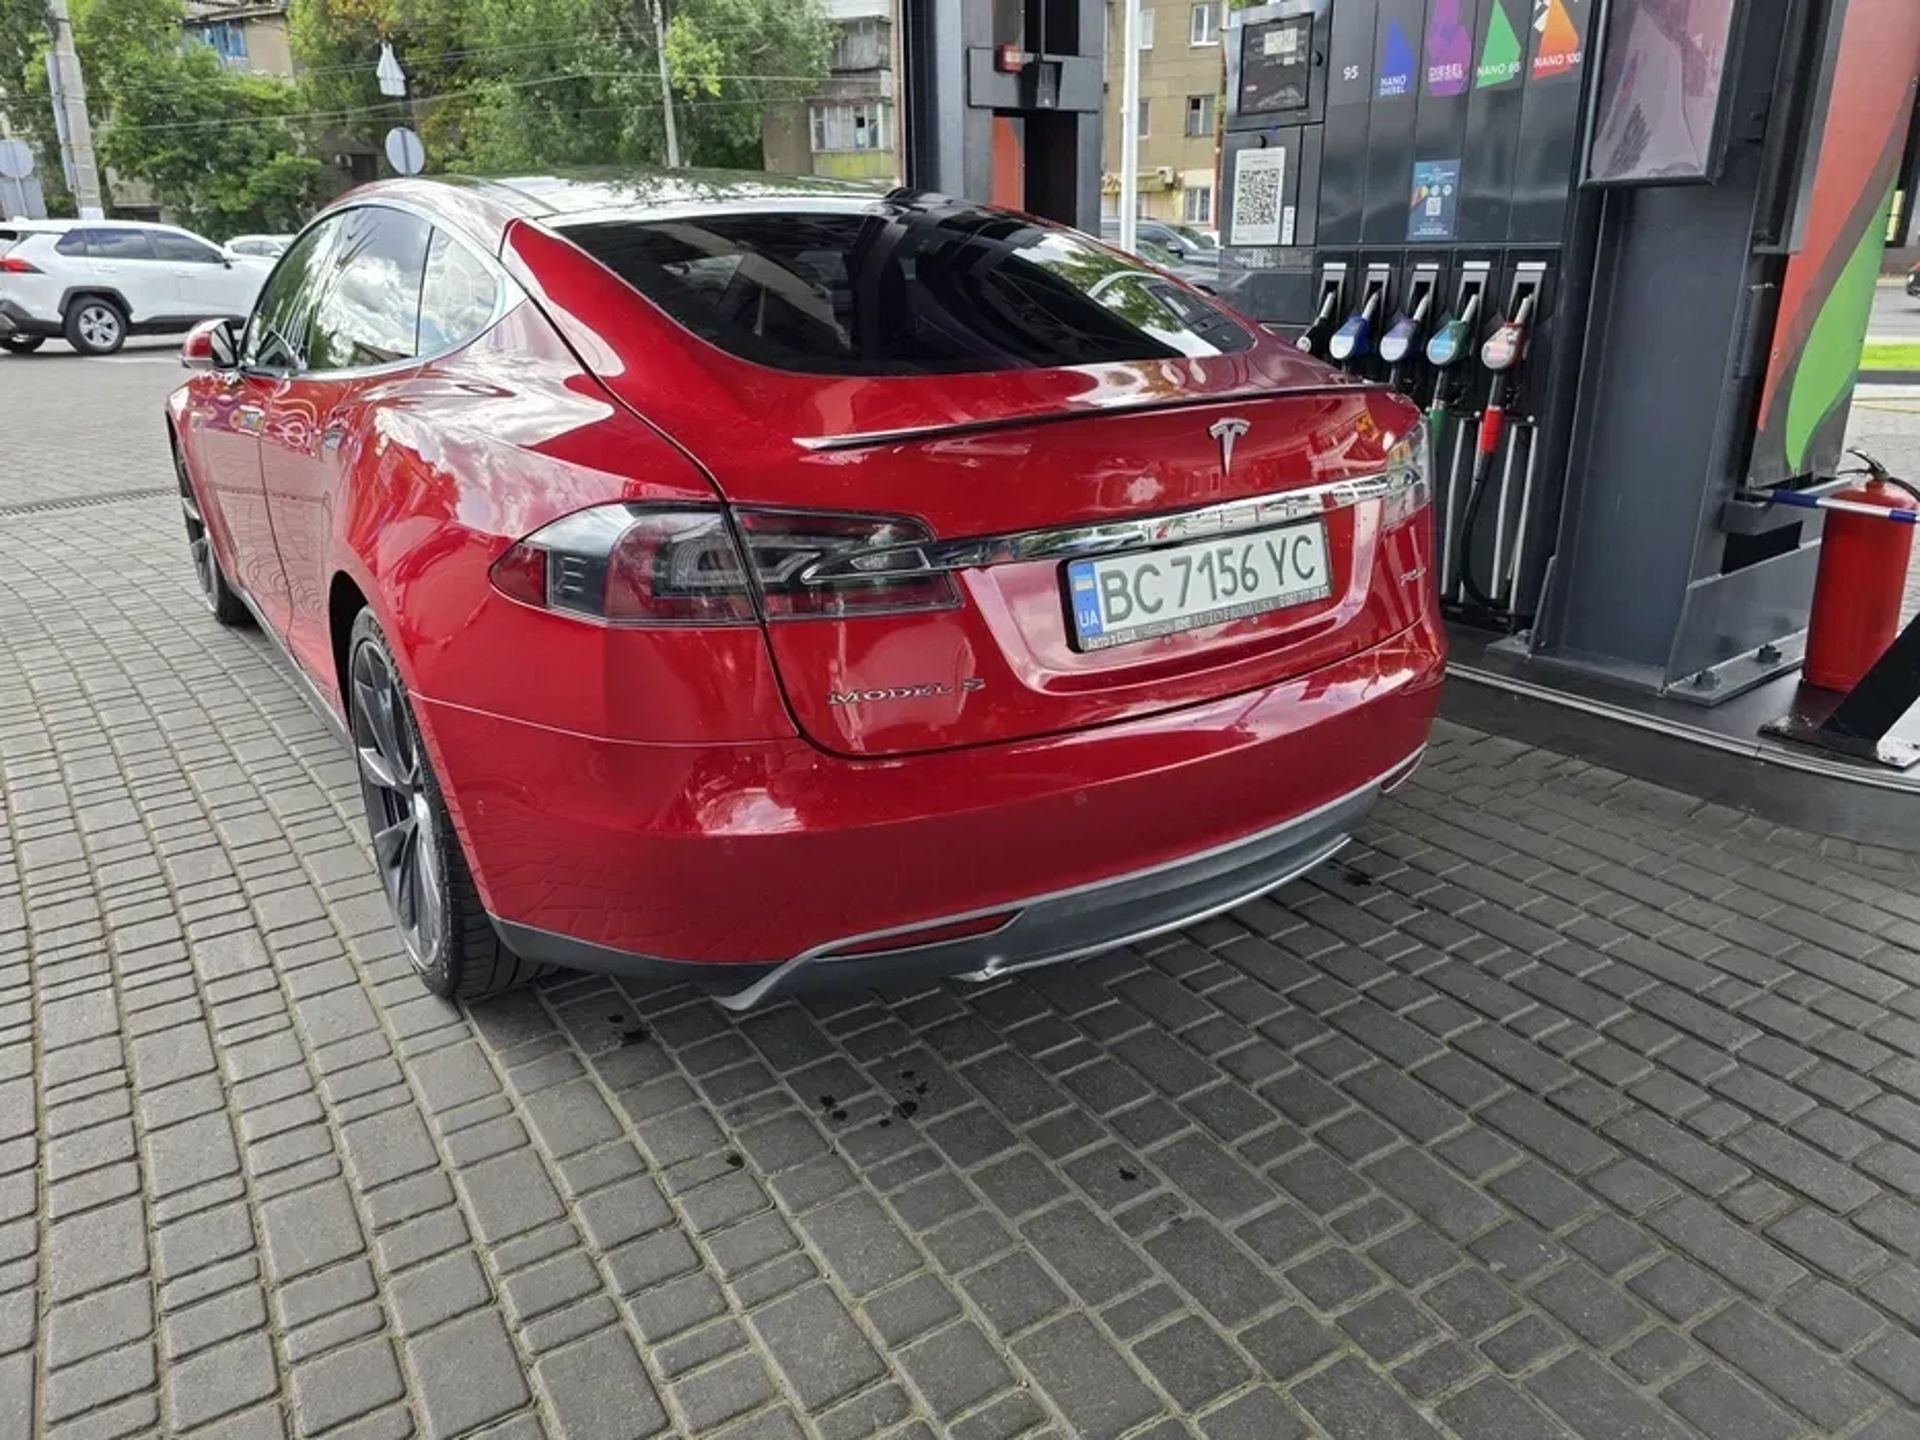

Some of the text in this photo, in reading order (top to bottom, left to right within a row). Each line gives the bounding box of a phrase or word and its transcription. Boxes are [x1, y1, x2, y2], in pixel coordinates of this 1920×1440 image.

[1534, 50, 1582, 69] NANO 100
[1344, 65, 1359, 80] 95
[1477, 64, 1505, 77] NANO
[1380, 74, 1407, 86] NANO
[1100, 564, 1163, 624] BC
[1170, 544, 1259, 608] 7156
[1079, 609, 1099, 627] UA
[829, 683, 953, 705] MODEL
